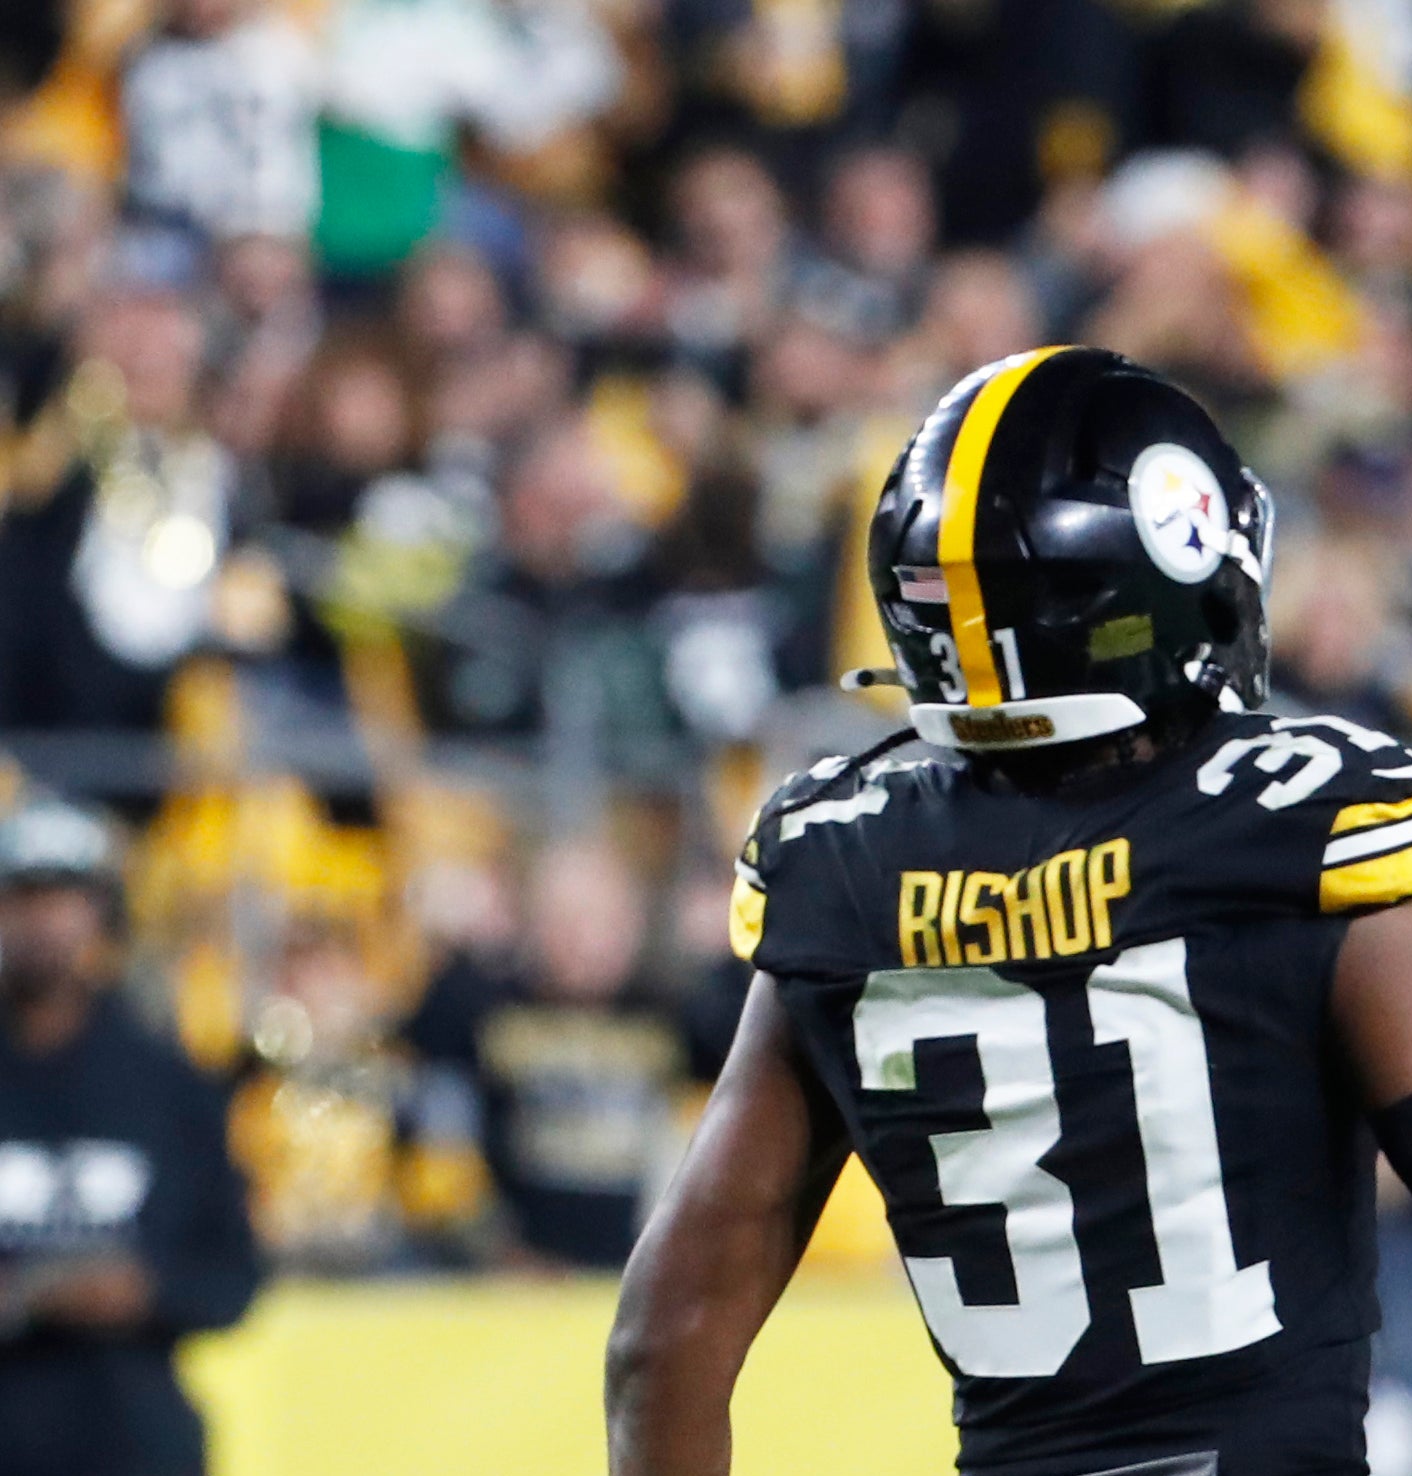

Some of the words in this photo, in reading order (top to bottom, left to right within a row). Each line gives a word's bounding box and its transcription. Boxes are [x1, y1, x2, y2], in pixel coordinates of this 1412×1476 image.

[930, 627, 1026, 704] 31
[898, 837, 1131, 968] BISHOP
[853, 937, 1283, 1378] 31
